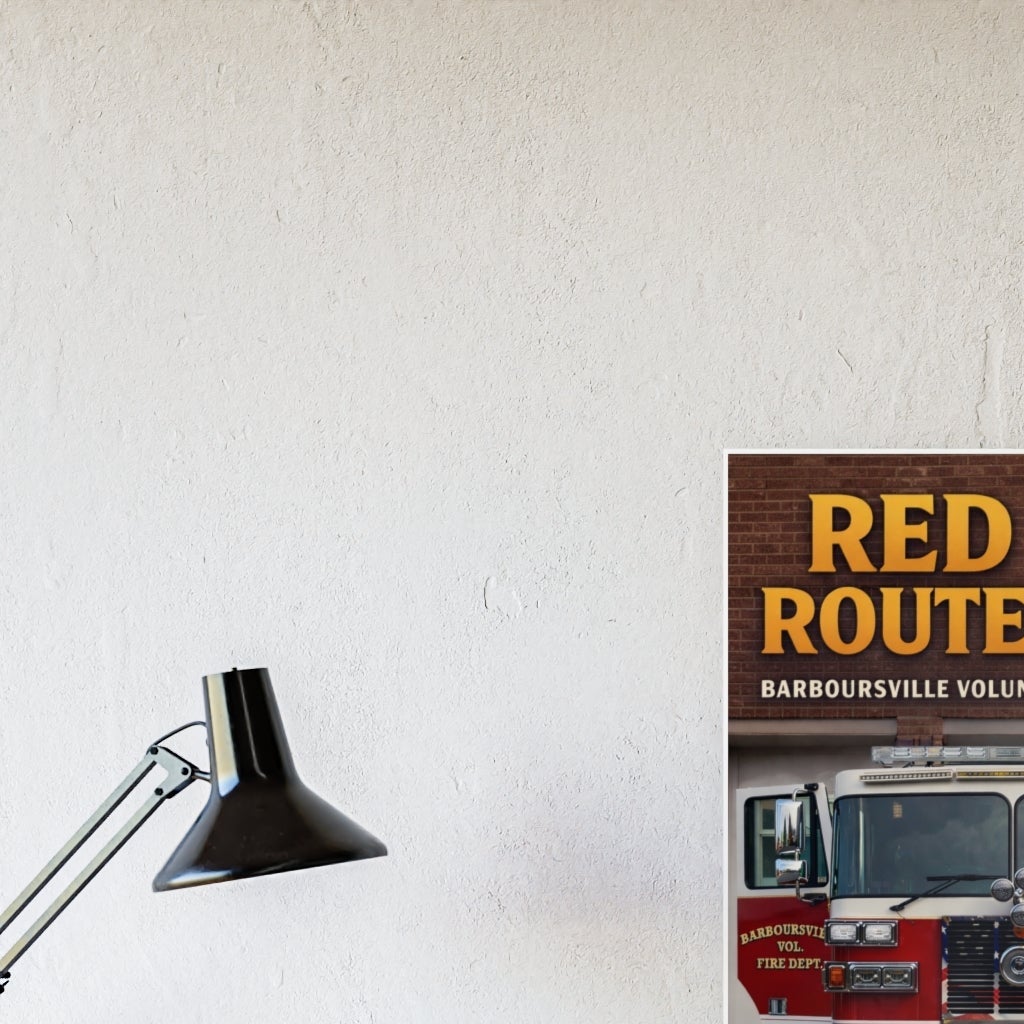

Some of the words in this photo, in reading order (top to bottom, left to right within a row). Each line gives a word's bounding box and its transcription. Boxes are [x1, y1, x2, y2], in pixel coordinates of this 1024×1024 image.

[808, 493, 1012, 573] RED
[760, 679, 950, 698] BARBOURSVILLE
[777, 941, 804, 952] VOL.
[757, 958, 786, 969] FIRE
[788, 958, 823, 970] DEPT.
